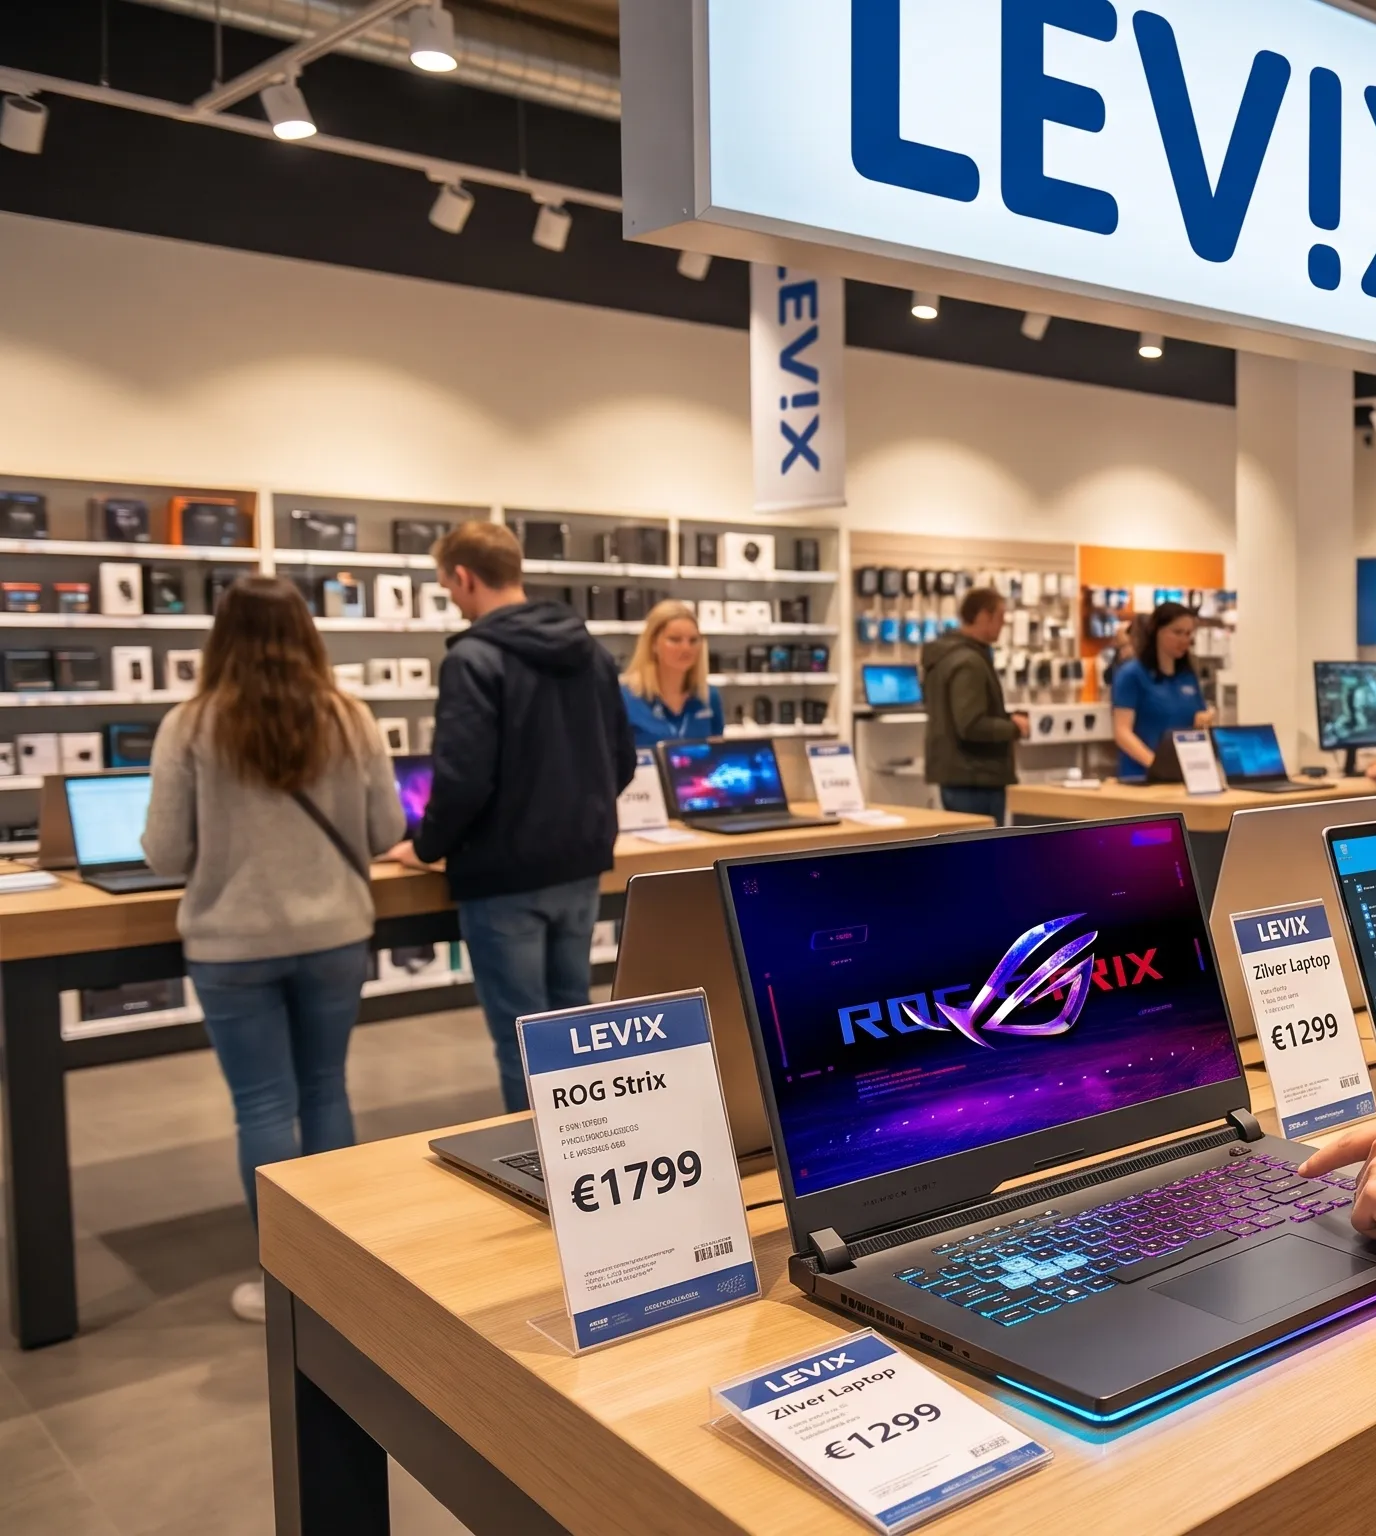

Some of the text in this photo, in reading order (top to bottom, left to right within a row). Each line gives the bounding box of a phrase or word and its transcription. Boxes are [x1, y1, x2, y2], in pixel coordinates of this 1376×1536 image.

[1257, 915, 1310, 943] LEVIX
[1252, 953, 1331, 981] Zilver Laptop
[1271, 1013, 1339, 1051] €1299
[552, 1070, 667, 1110] ROG Strix
[570, 1149, 702, 1214] €1799
[764, 1352, 856, 1393] LEVIX
[766, 1366, 896, 1421] Zilver Laptop
[824, 1402, 942, 1462] €1299
